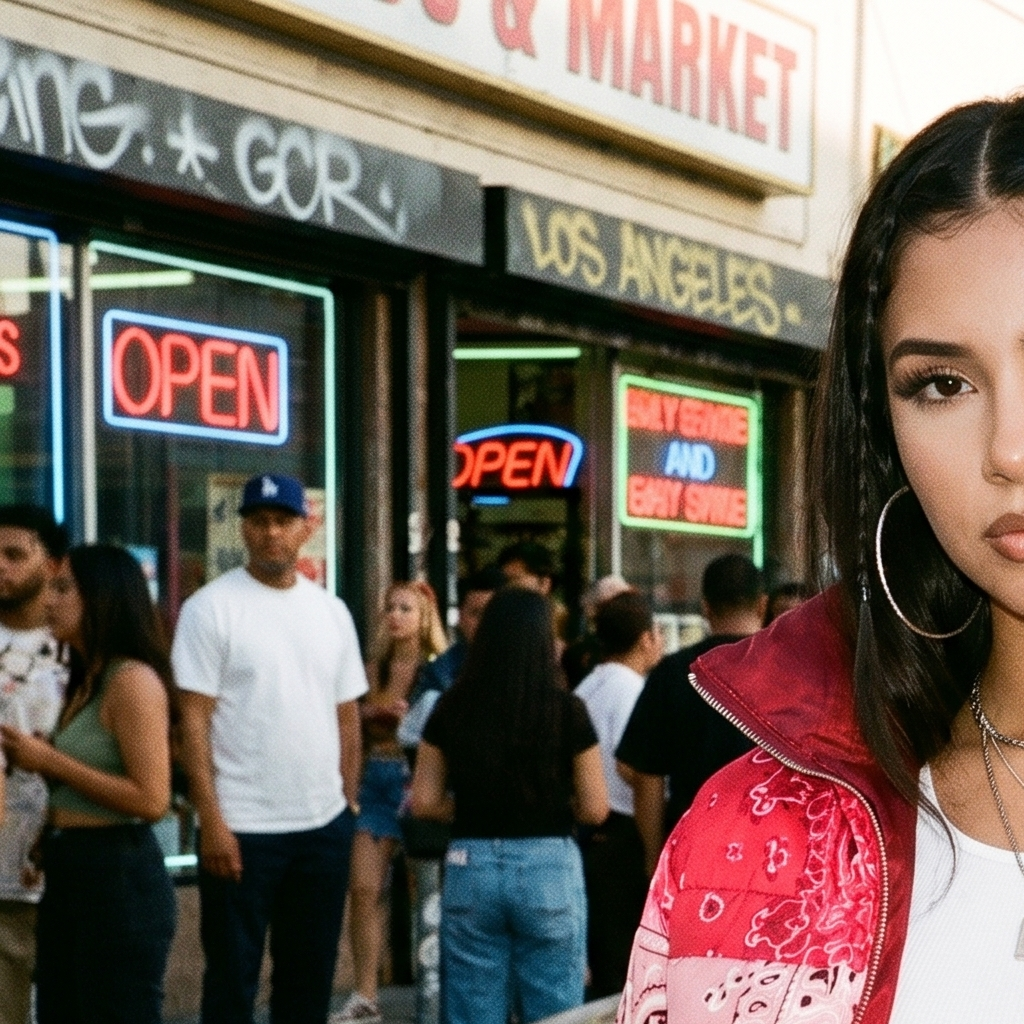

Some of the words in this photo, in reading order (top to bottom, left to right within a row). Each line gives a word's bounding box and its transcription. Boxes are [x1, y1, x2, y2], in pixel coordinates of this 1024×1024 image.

[567, 0, 797, 152] MARKET
[521, 200, 608, 287] LOS
[113, 326, 279, 432] OPEN
[664, 439, 717, 482] AND
